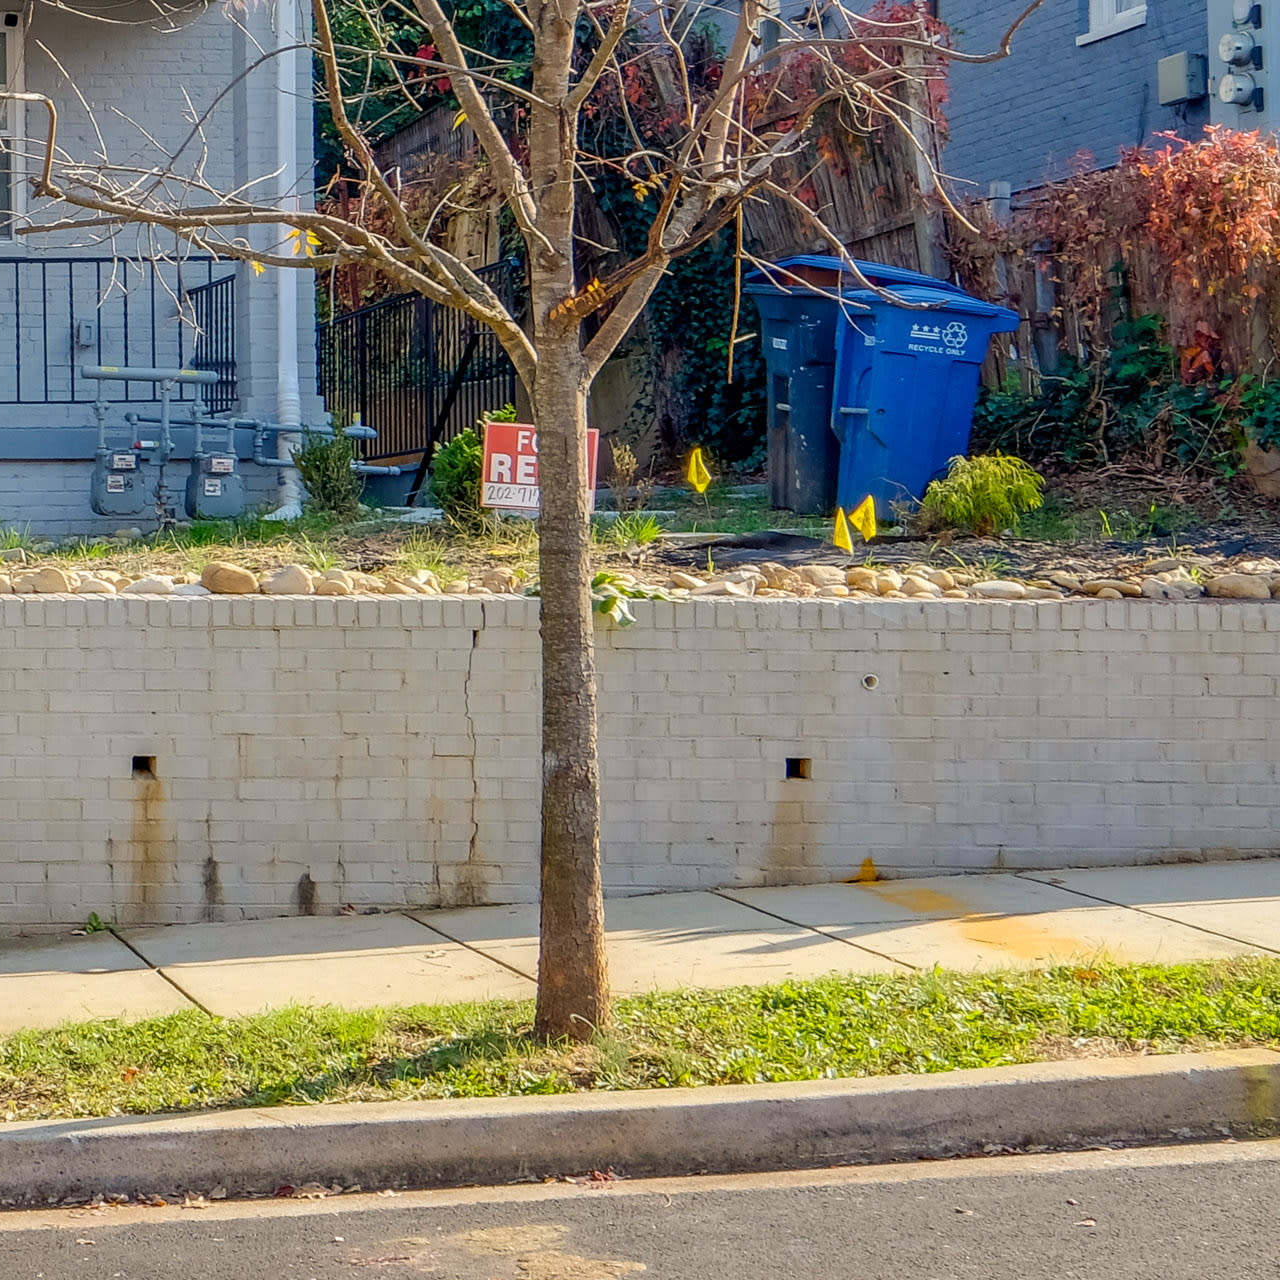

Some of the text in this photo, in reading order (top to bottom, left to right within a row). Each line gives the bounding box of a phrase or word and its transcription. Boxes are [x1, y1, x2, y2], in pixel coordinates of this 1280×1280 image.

[908, 343, 966, 356] RECYCLE ONLY
[517, 430, 539, 453] FO
[489, 453, 538, 484] RE
